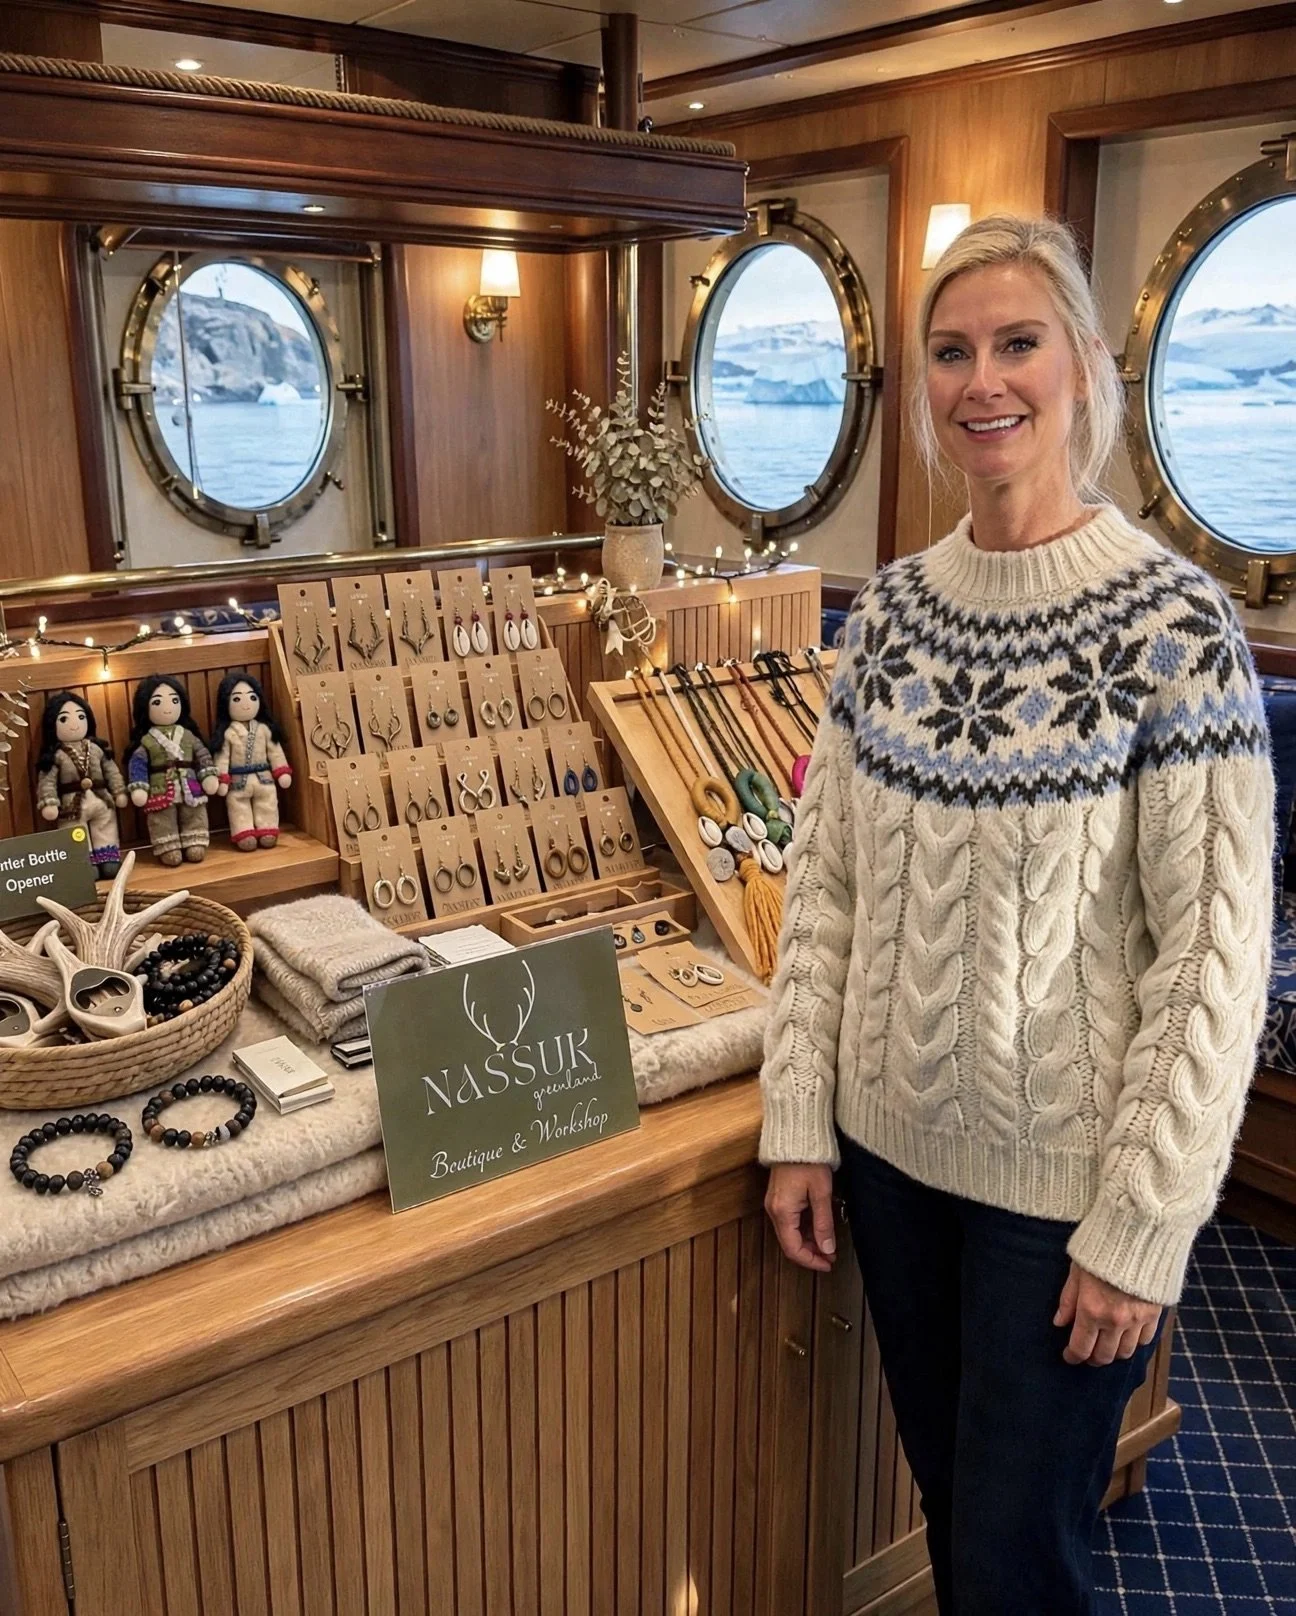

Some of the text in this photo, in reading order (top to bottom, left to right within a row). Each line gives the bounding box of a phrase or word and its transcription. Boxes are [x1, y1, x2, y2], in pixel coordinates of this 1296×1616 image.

[28, 849, 68, 866] Bottle
[6, 873, 54, 894] Opener
[421, 1027, 594, 1116] NASSUK
[533, 1061, 602, 1112] greenland
[511, 1132, 527, 1153] &
[530, 1097, 609, 1144] Workshop
